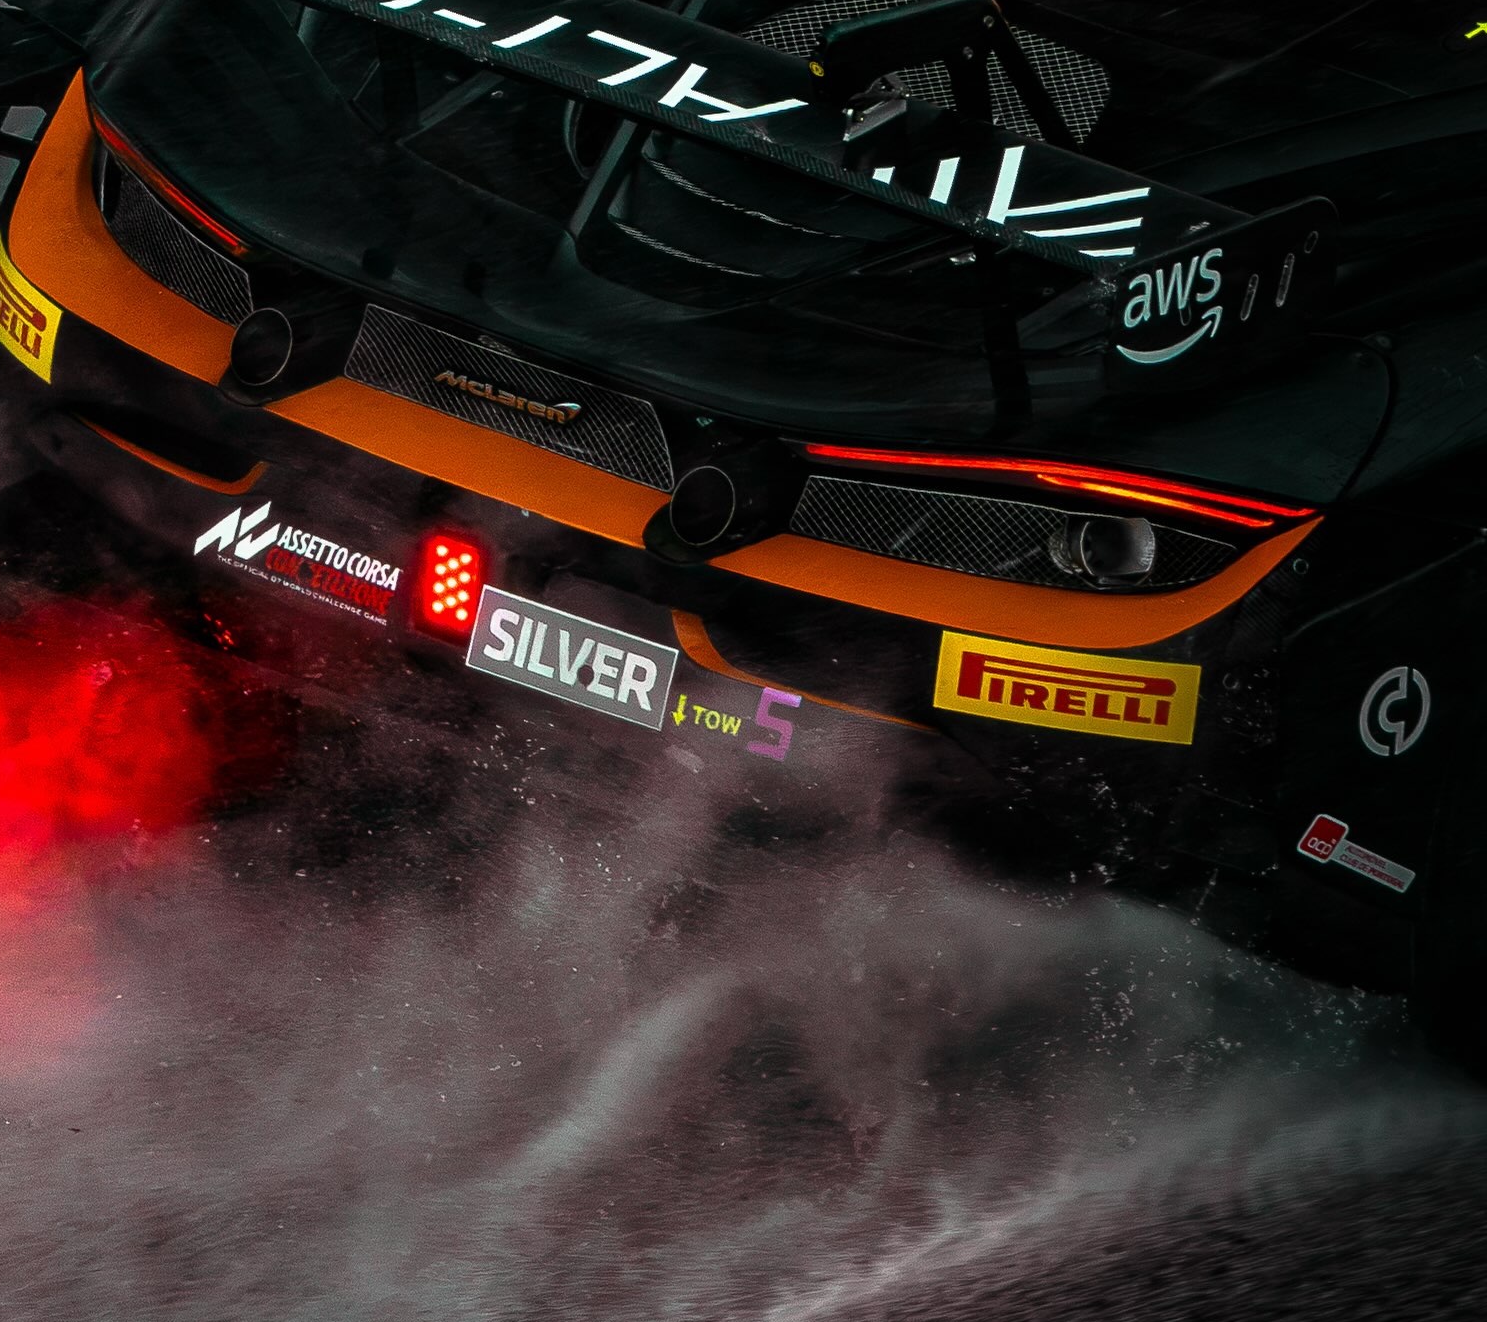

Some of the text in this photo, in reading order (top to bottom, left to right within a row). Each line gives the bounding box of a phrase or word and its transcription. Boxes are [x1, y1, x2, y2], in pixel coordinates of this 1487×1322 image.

[1123, 247, 1224, 329] aws
[432, 368, 570, 426] McLaren
[277, 525, 400, 592] ASSETTO CORSA
[483, 607, 657, 712] SILVER
[957, 651, 1177, 725] PIRELLI
[693, 705, 742, 737] TOW
